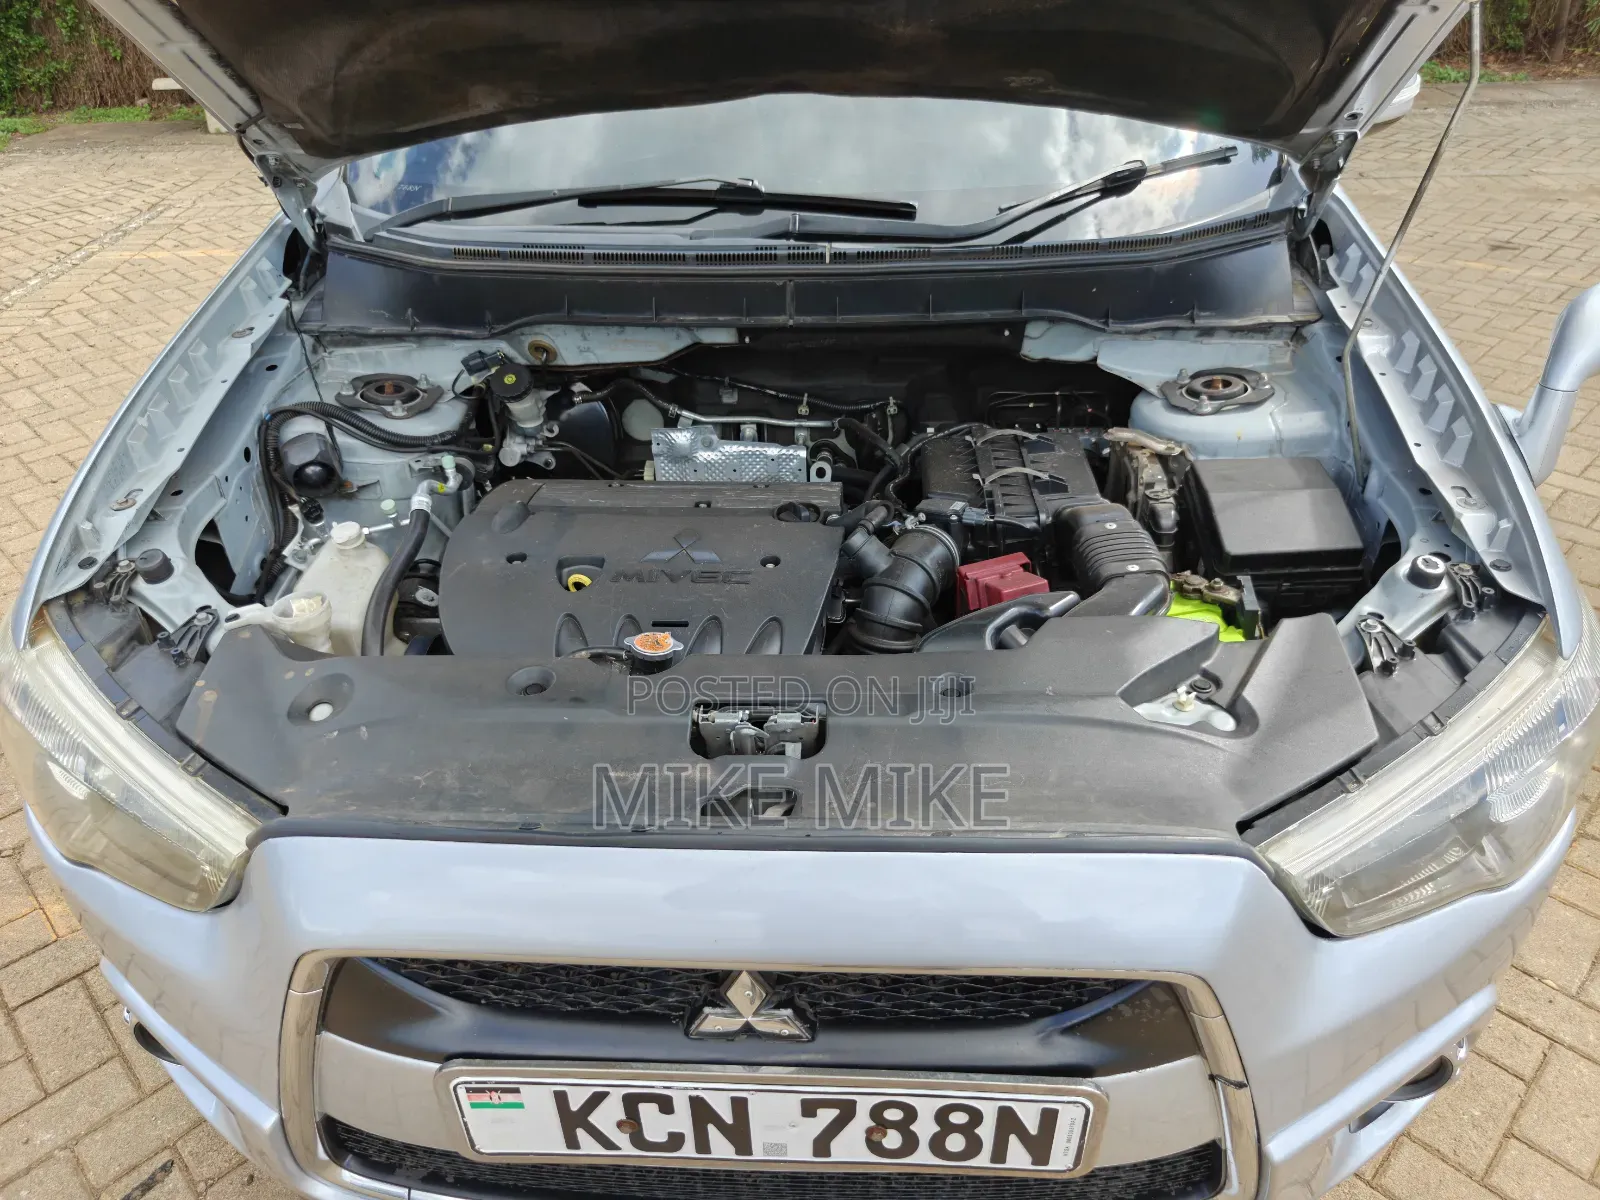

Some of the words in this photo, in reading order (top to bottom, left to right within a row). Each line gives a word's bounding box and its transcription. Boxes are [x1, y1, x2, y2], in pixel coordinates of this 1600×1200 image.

[610, 569, 752, 584] MIVEC
[552, 1088, 755, 1157] KCN
[800, 1098, 1060, 1167] 788N
